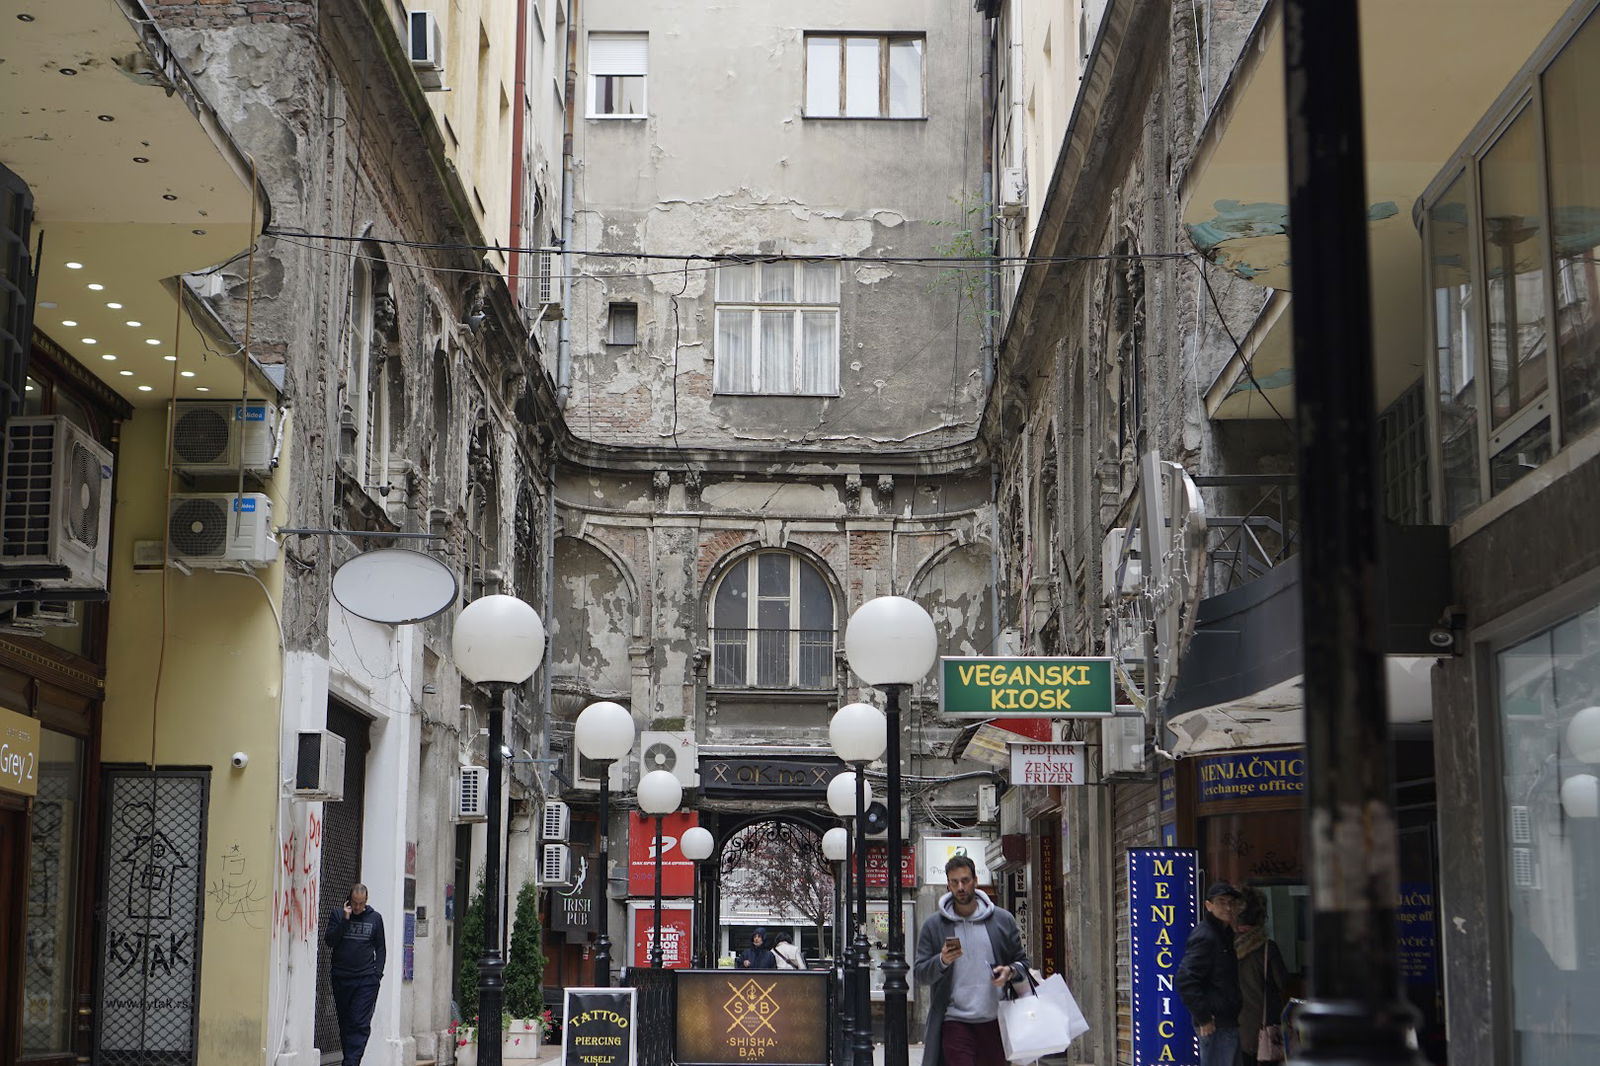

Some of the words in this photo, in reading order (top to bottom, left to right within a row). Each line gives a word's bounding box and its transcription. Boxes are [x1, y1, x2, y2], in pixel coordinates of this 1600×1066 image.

[958, 664, 1091, 686] VEGANSKI
[991, 688, 1072, 710] KIOSK
[1022, 744, 1075, 755] PEDIKIR
[0, 743, 26, 784] Grey
[26, 751, 34, 780] 2
[1025, 760, 1073, 773] ŽENSKI
[1201, 756, 1305, 781] MENJAČNIC
[1025, 773, 1073, 783] FRIZER
[1205, 782, 1255, 795] exchange
[1259, 779, 1304, 791] office
[563, 898, 592, 912] IRISH
[567, 912, 588, 925] PUB
[647, 933, 679, 941] VLIKI
[1150, 859, 1176, 1062] MENJAČNICA
[734, 1001, 743, 1014] S
[760, 1001, 770, 1014] B
[569, 1009, 629, 1029] TATTOO
[575, 1036, 622, 1046] PIERCING
[729, 1037, 775, 1047] SHISHA
[739, 1047, 765, 1057] BAR
